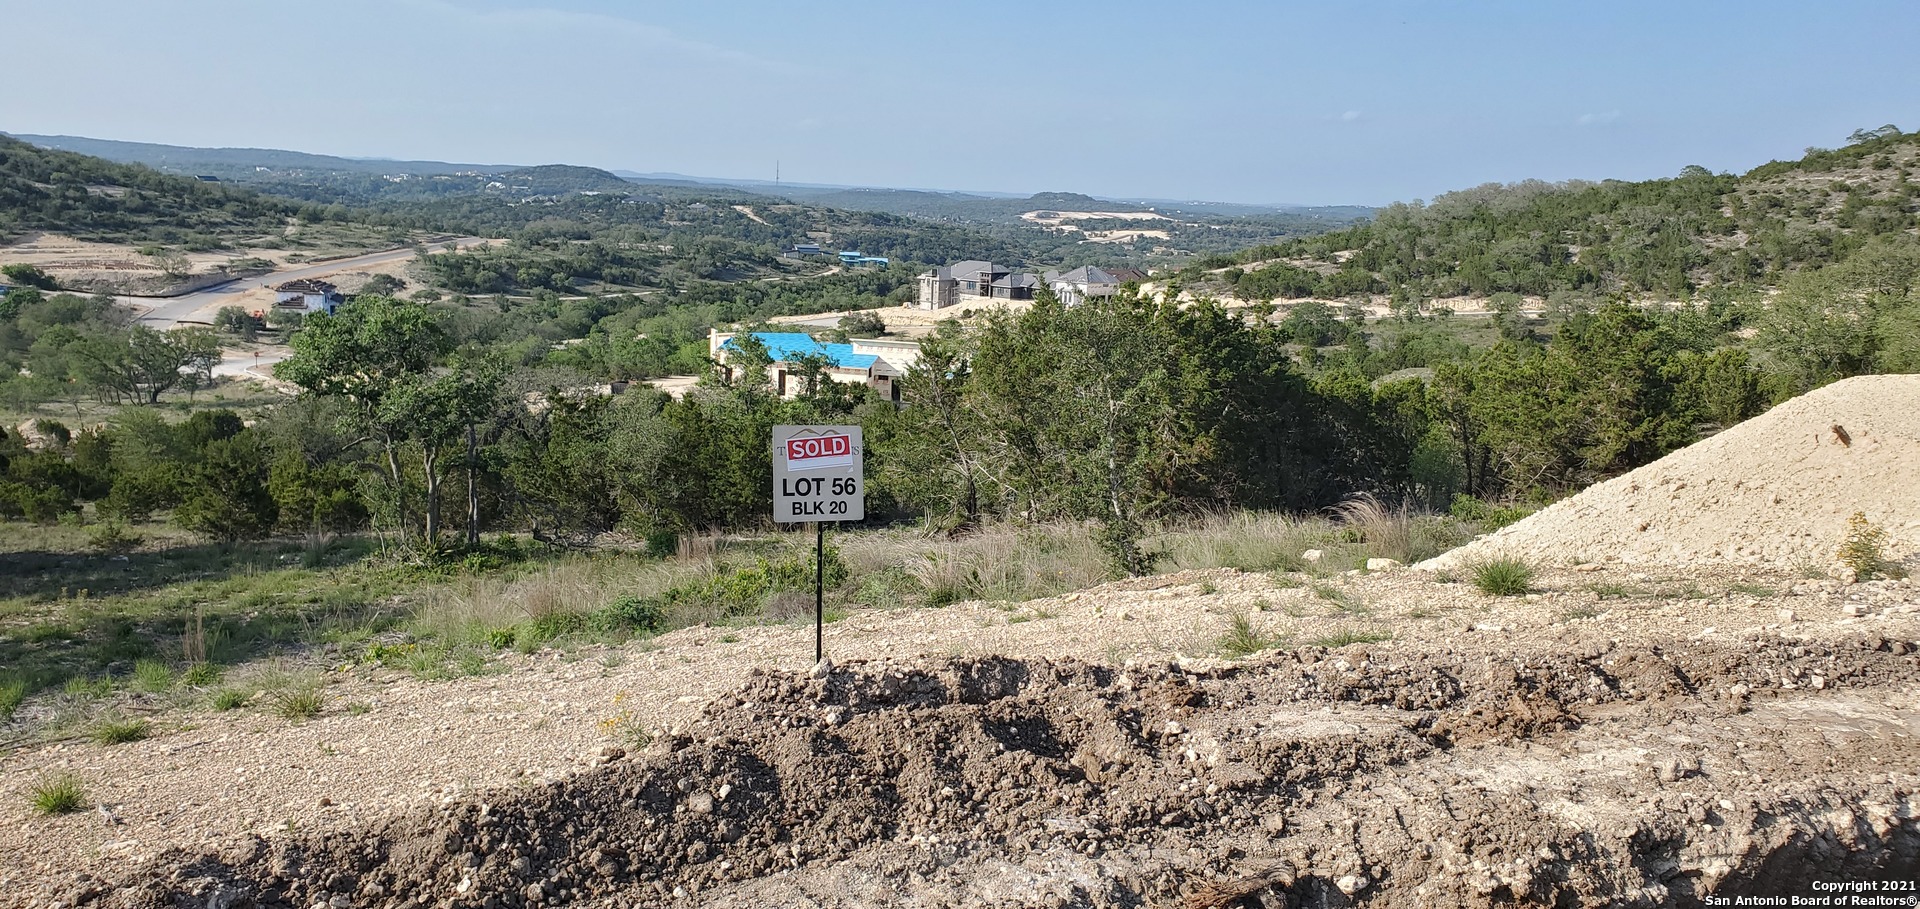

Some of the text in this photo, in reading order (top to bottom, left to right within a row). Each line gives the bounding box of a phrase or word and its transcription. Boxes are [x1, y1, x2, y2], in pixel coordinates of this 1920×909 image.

[792, 438, 845, 458] SOLD
[782, 477, 856, 497] LOT 56
[792, 500, 848, 515] BLK 20
